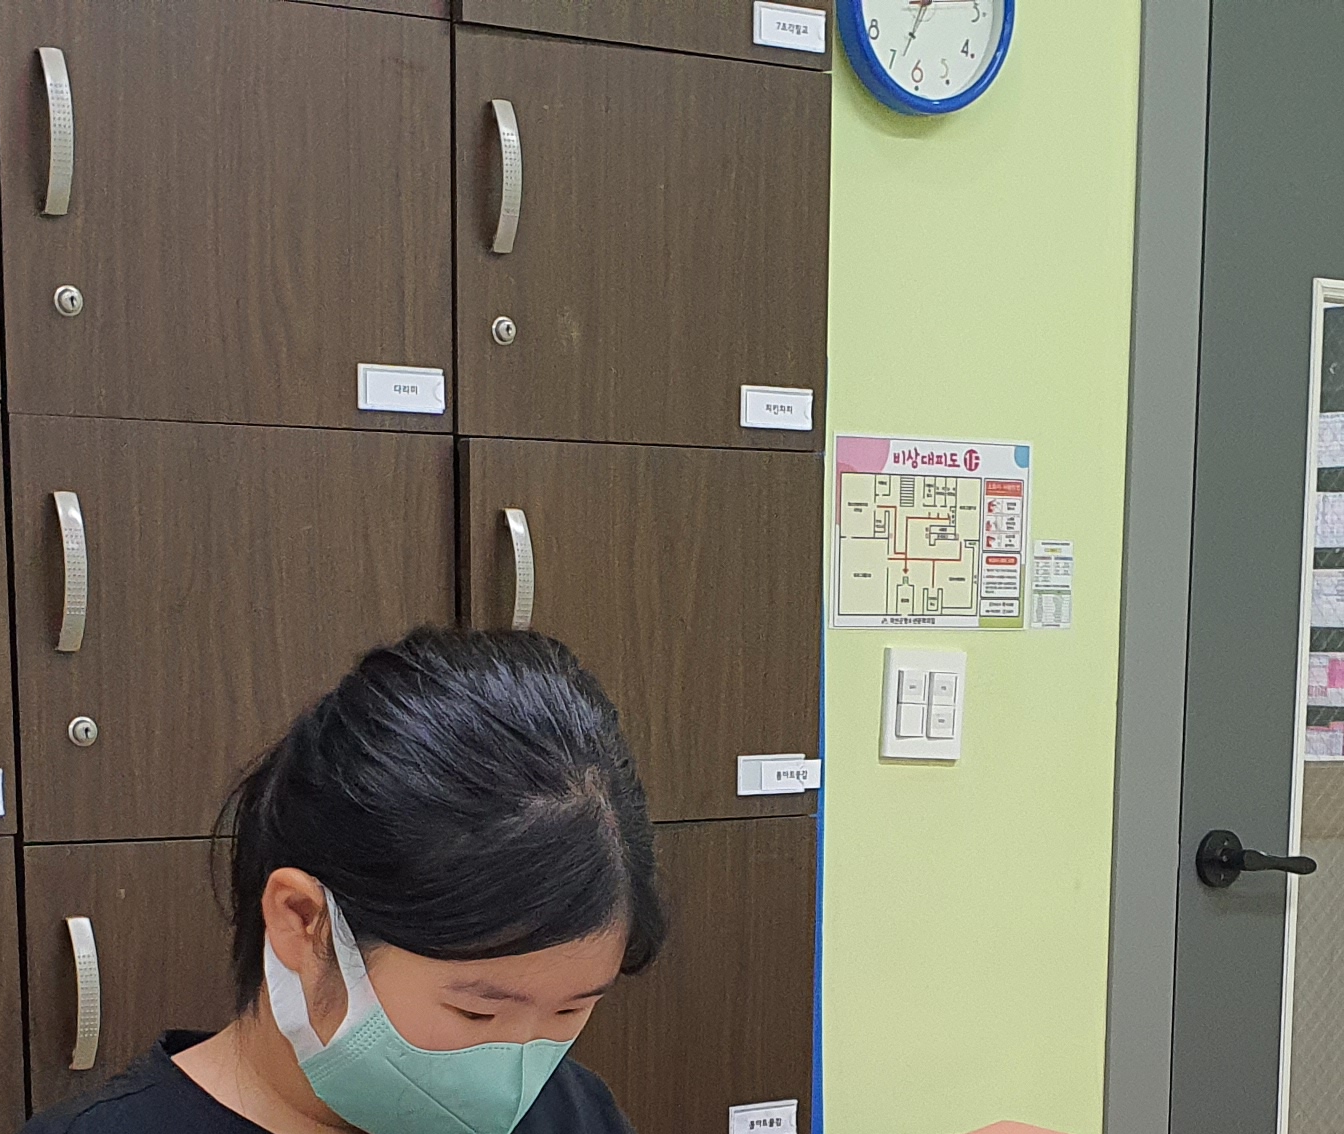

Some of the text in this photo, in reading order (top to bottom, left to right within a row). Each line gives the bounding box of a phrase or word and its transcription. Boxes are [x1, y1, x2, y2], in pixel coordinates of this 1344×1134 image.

[868, 18, 880, 40] 8
[960, 38, 970, 57] 4
[889, 48, 897, 70] 7
[939, 58, 949, 79] 5
[911, 59, 924, 83] 6
[893, 447, 960, 469] 비상대피도
